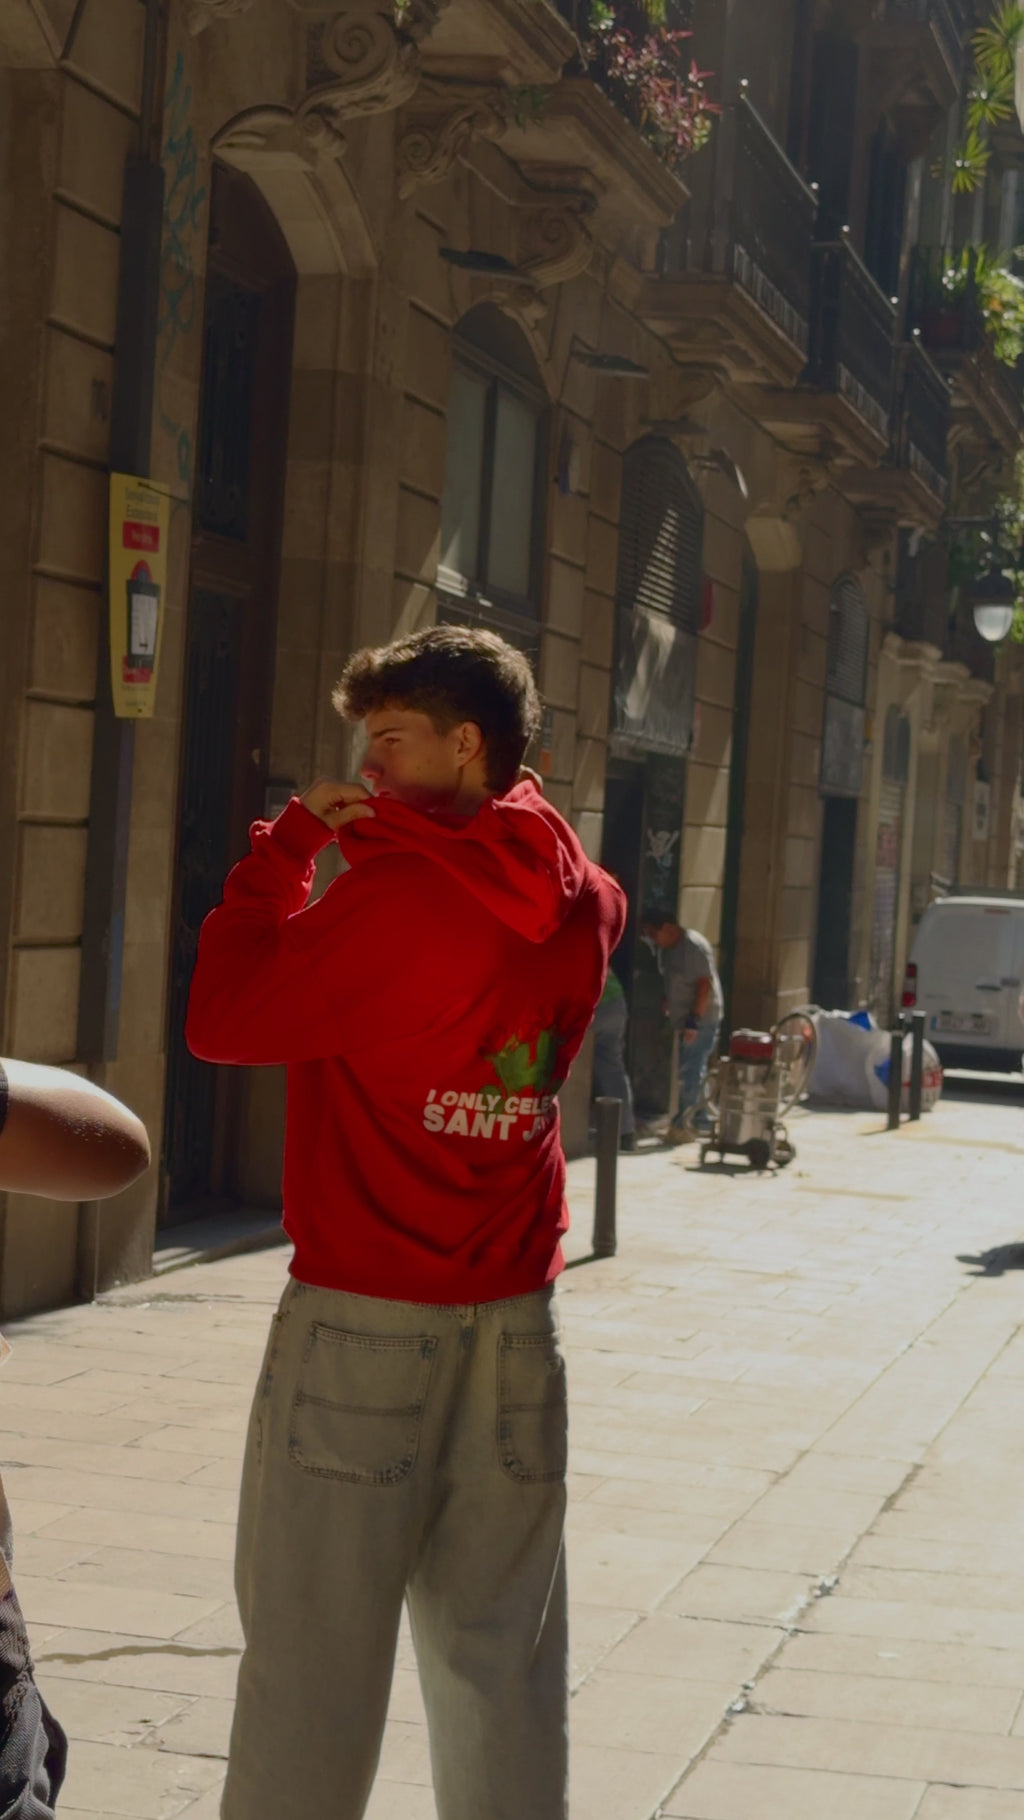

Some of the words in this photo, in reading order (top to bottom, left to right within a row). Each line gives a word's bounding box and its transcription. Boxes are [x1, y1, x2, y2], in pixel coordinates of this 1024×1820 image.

[427, 1089, 437, 1103] I
[441, 1091, 502, 1111] ONLY
[424, 1104, 518, 1141] SANT
